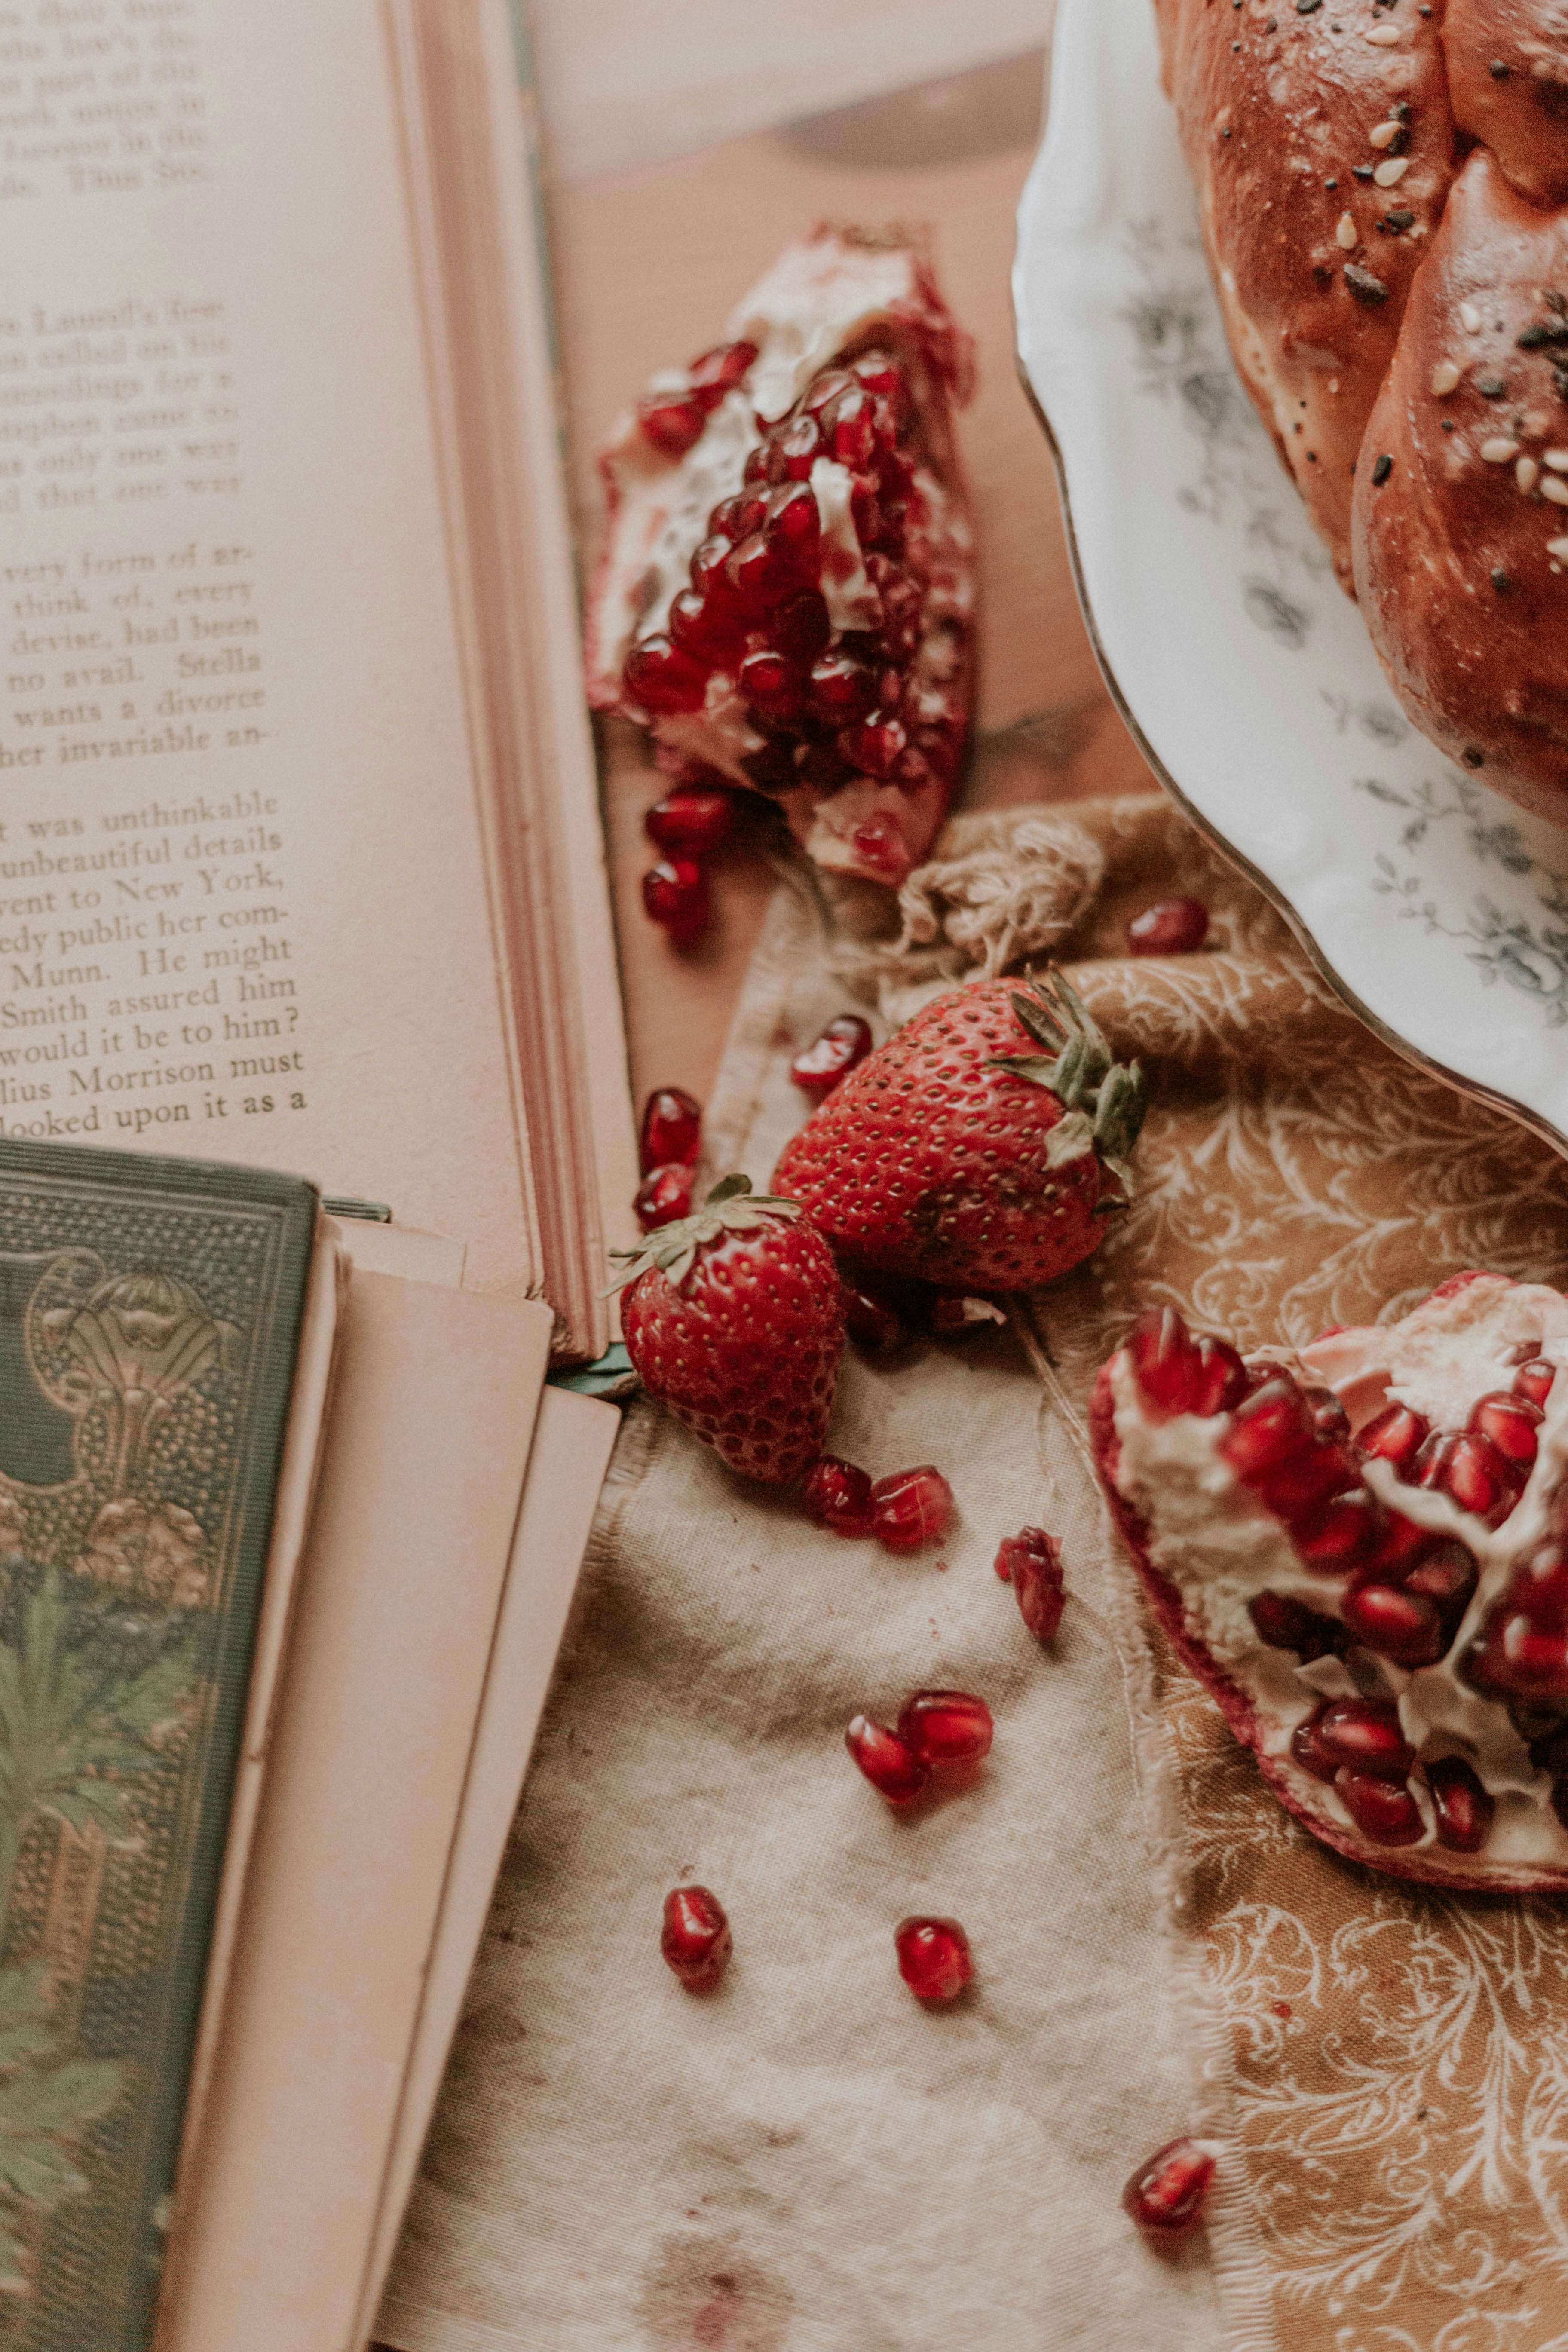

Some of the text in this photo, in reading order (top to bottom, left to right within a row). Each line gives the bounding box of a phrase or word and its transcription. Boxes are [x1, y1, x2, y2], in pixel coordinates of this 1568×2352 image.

[80, 550, 156, 577] form
[165, 543, 197, 571] of
[13, 588, 89, 619] think
[175, 581, 254, 606] every
[125, 618, 178, 645] had
[190, 616, 259, 640] been
[8, 674, 44, 693] no
[177, 647, 261, 678] Stella
[14, 688, 266, 727] wants a divorce
[59, 725, 212, 763] invariable
[28, 819, 84, 839] was
[103, 791, 279, 832] unthinkable
[1, 826, 282, 879] unbeautiful details
[70, 891, 101, 910] to
[115, 877, 184, 903] New
[198, 863, 285, 894] York,
[59, 915, 149, 954] public
[157, 911, 207, 937] her
[218, 906, 288, 928] com-
[12, 938, 293, 991] Munn. He might
[1, 974, 296, 1029] Smith assured him
[0, 1031, 88, 1067] would
[101, 1027, 123, 1055] it
[134, 1025, 170, 1050] be
[182, 1025, 212, 1044] to
[69, 1060, 216, 1096] Morrison
[231, 1052, 304, 1078] must
[0, 1091, 308, 1137] looked upon it as a
